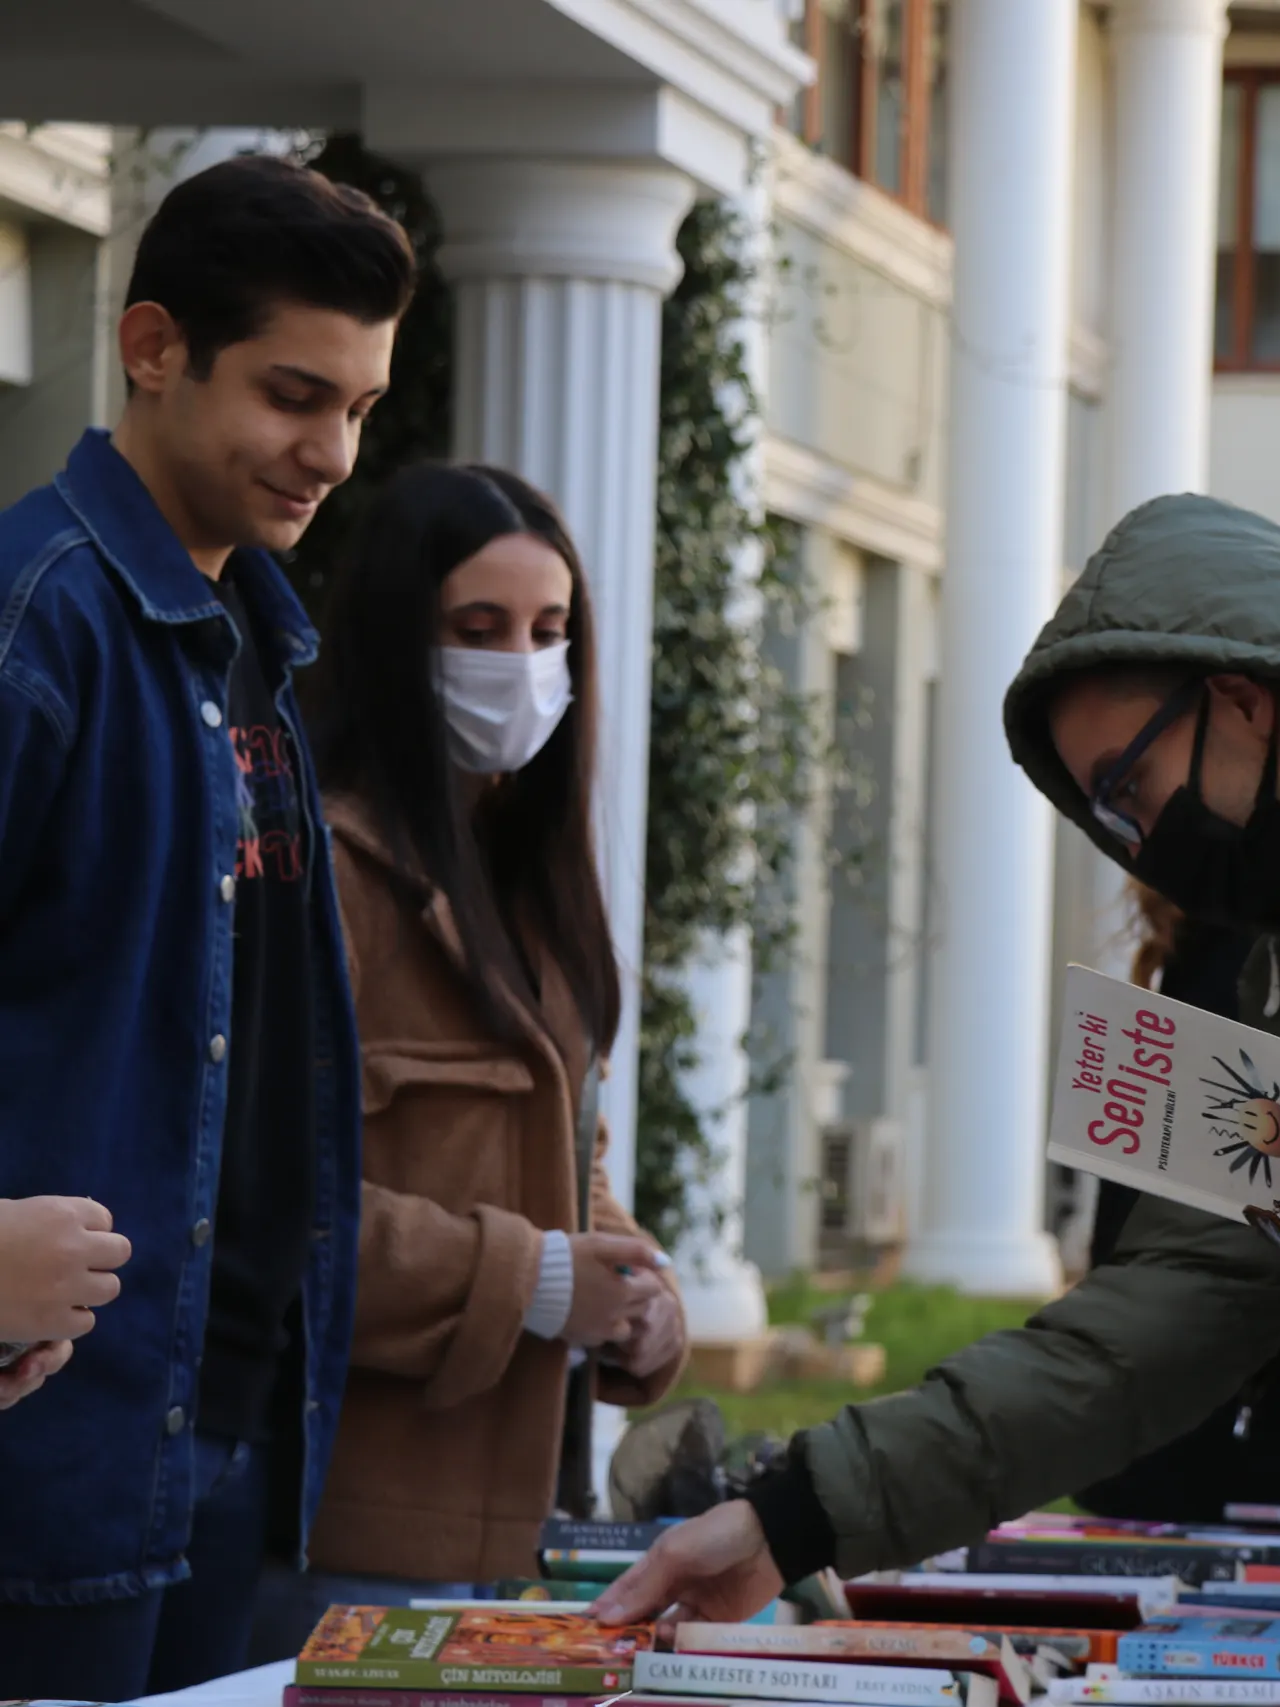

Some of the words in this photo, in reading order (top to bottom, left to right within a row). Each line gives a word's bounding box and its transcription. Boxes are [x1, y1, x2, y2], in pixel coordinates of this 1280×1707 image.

[1077, 1010, 1108, 1037] ki
[1072, 1036, 1106, 1093] Yeter
[1087, 1078, 1148, 1155] Sen
[1158, 1123, 1173, 1171] PSİKOTERAPİ
[1212, 1650, 1266, 1669] TÜRKÇE
[440, 1667, 470, 1686] ÇİN
[649, 1663, 684, 1679] CAM
[687, 1665, 755, 1685] KAFESTE
[758, 1670, 767, 1684] 7
[770, 1671, 838, 1690] SOYTARI
